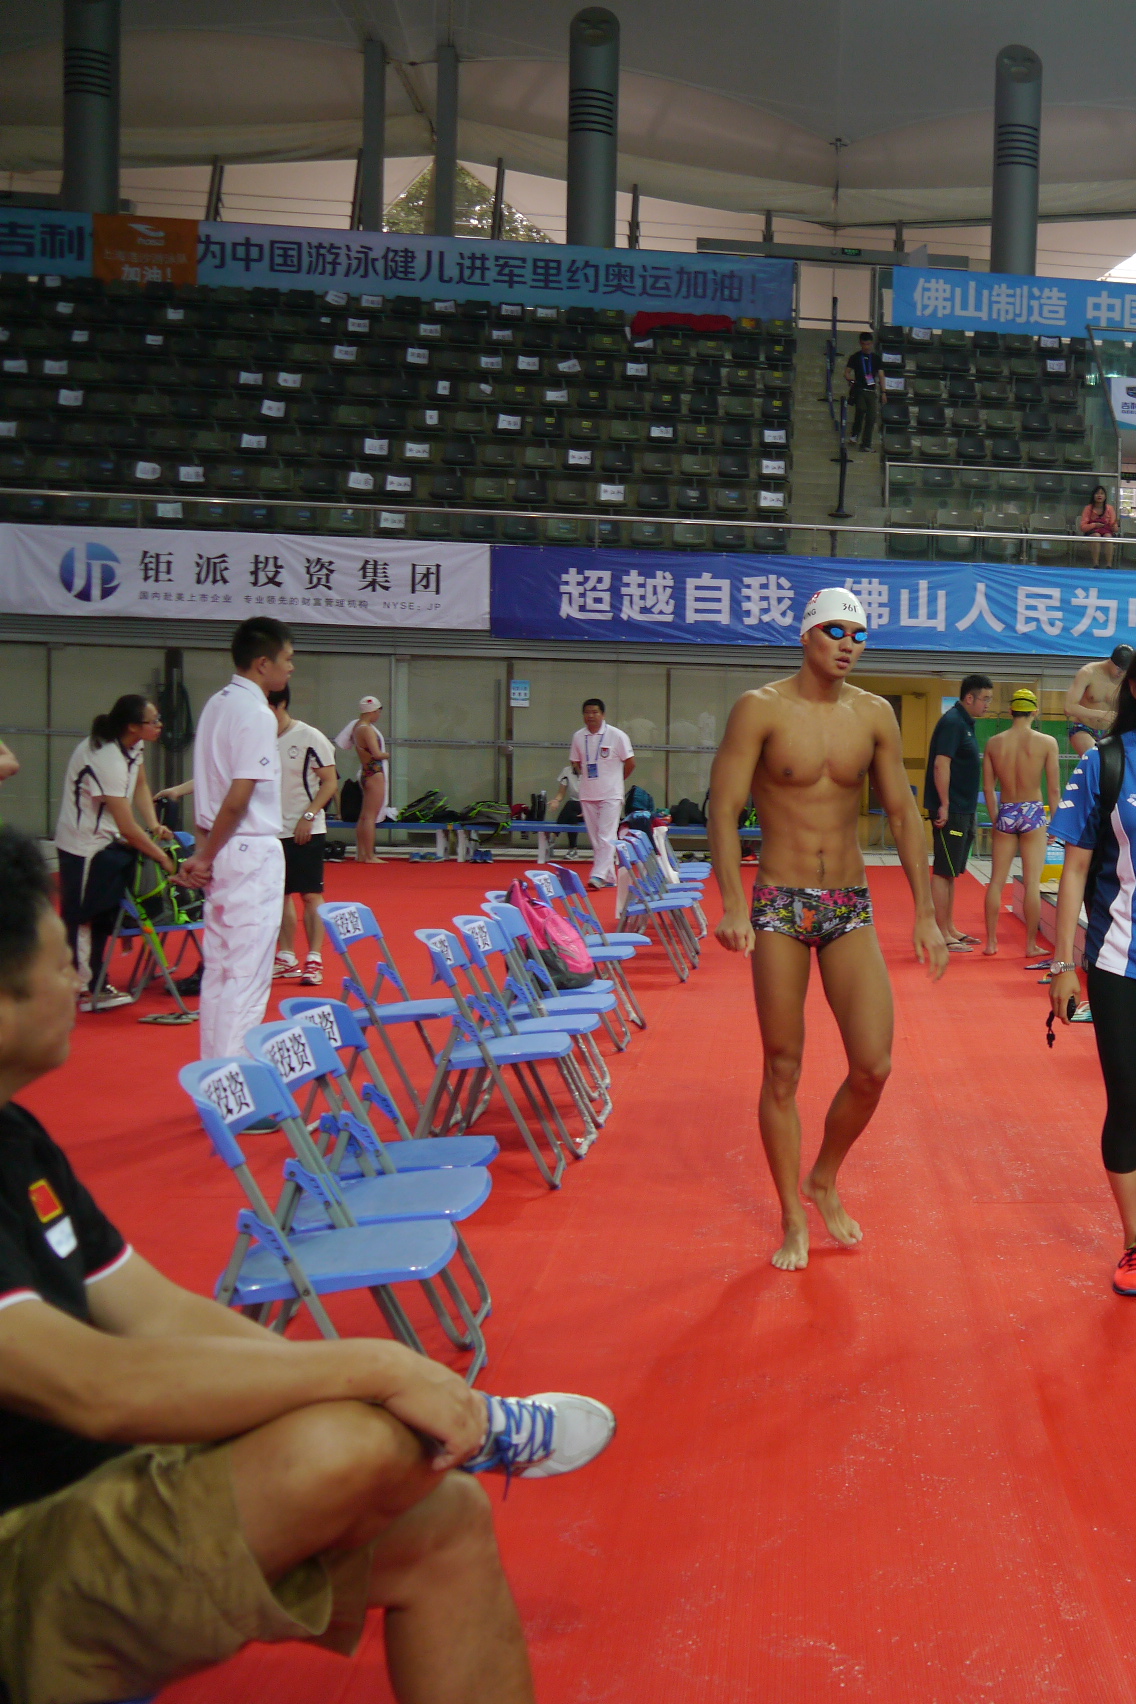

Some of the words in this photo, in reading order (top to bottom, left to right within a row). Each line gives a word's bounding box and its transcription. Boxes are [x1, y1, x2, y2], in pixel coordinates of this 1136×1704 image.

[913, 277, 1068, 327] 佛山制造
[139, 549, 442, 596] 钜派投资集团
[558, 567, 800, 628] 超越自我
